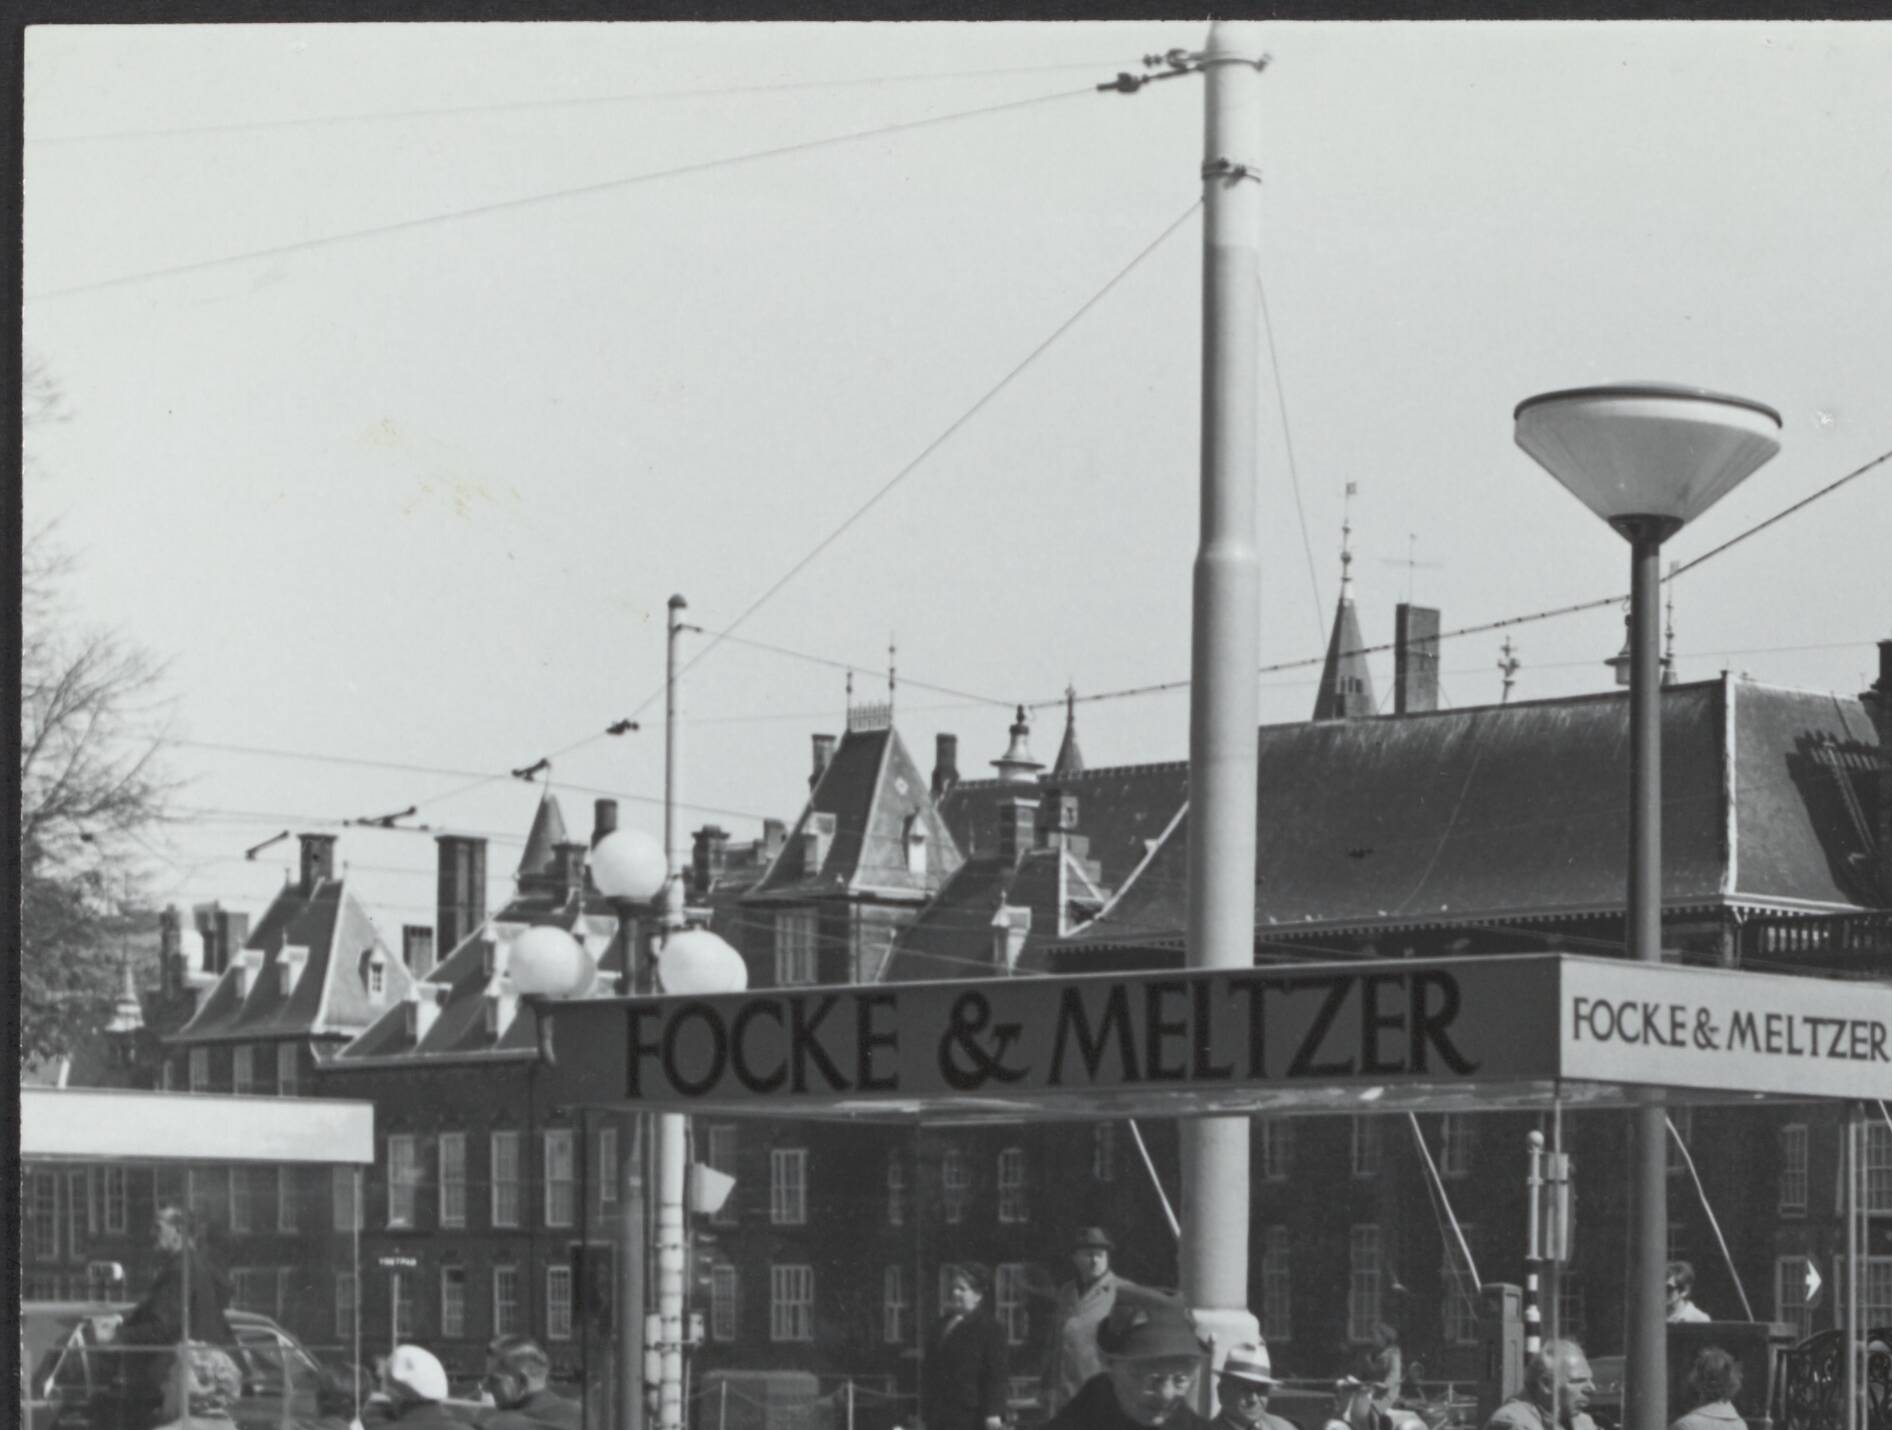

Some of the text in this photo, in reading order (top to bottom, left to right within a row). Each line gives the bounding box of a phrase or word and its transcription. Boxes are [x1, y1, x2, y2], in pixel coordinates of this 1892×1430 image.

[625, 969, 1481, 1098] FOCKE & MELTZER
[1572, 996, 1686, 1048] FOCKE
[1726, 1010, 1891, 1063] MELTZER
